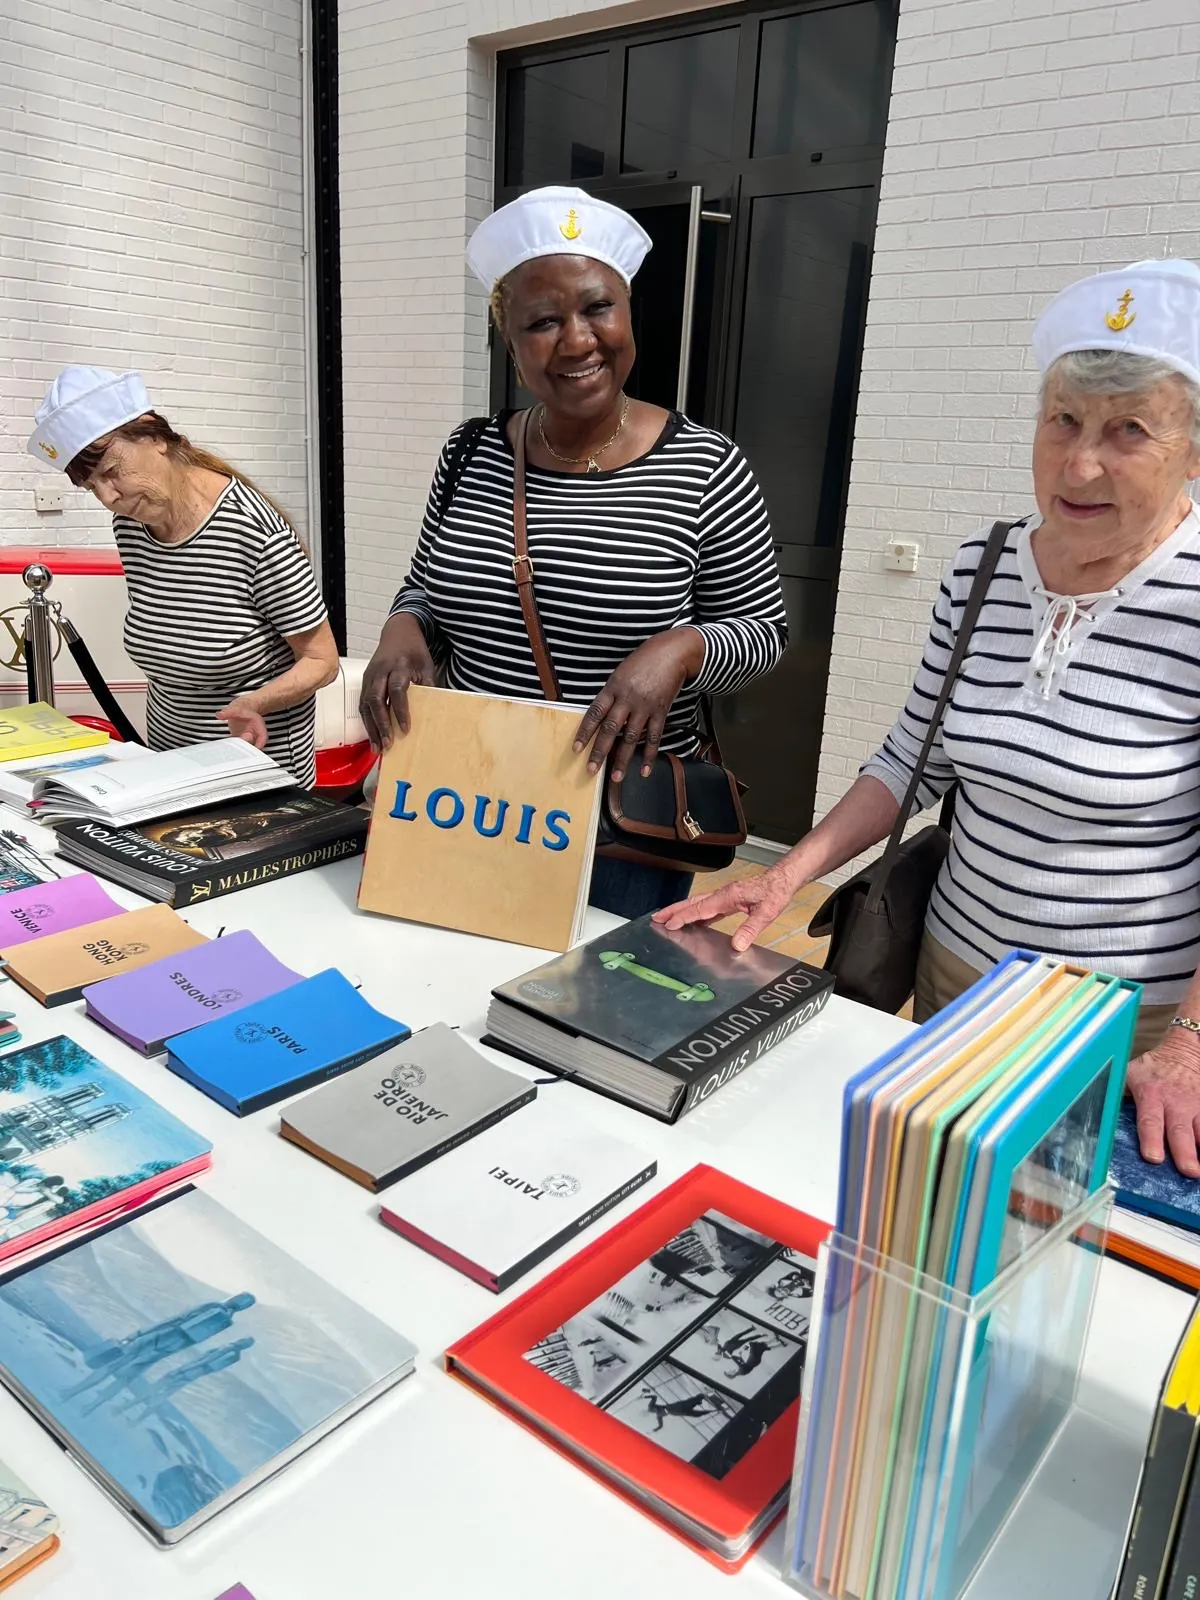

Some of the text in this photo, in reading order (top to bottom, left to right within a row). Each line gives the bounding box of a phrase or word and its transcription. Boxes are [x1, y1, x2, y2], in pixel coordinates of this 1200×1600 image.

[388, 779, 571, 851] LOUIS
[75, 823, 200, 874] LOUIS VUITTON
[218, 838, 358, 891] MALLES TROPHÉES
[10, 907, 42, 934] VENICE
[82, 943, 115, 966] HONG
[96, 939, 128, 961] KONG
[169, 971, 223, 1010] LONDRES
[759, 970, 822, 1008] LOUIS
[267, 1026, 308, 1055] PARIS
[667, 1006, 771, 1072] VUITTON
[689, 1050, 750, 1109] LOUIS
[756, 991, 828, 1059] VUITTON
[373, 1090, 428, 1125] RIO DE
[381, 1078, 449, 1120] JANEIRO
[488, 1166, 546, 1200] TAIPEI
